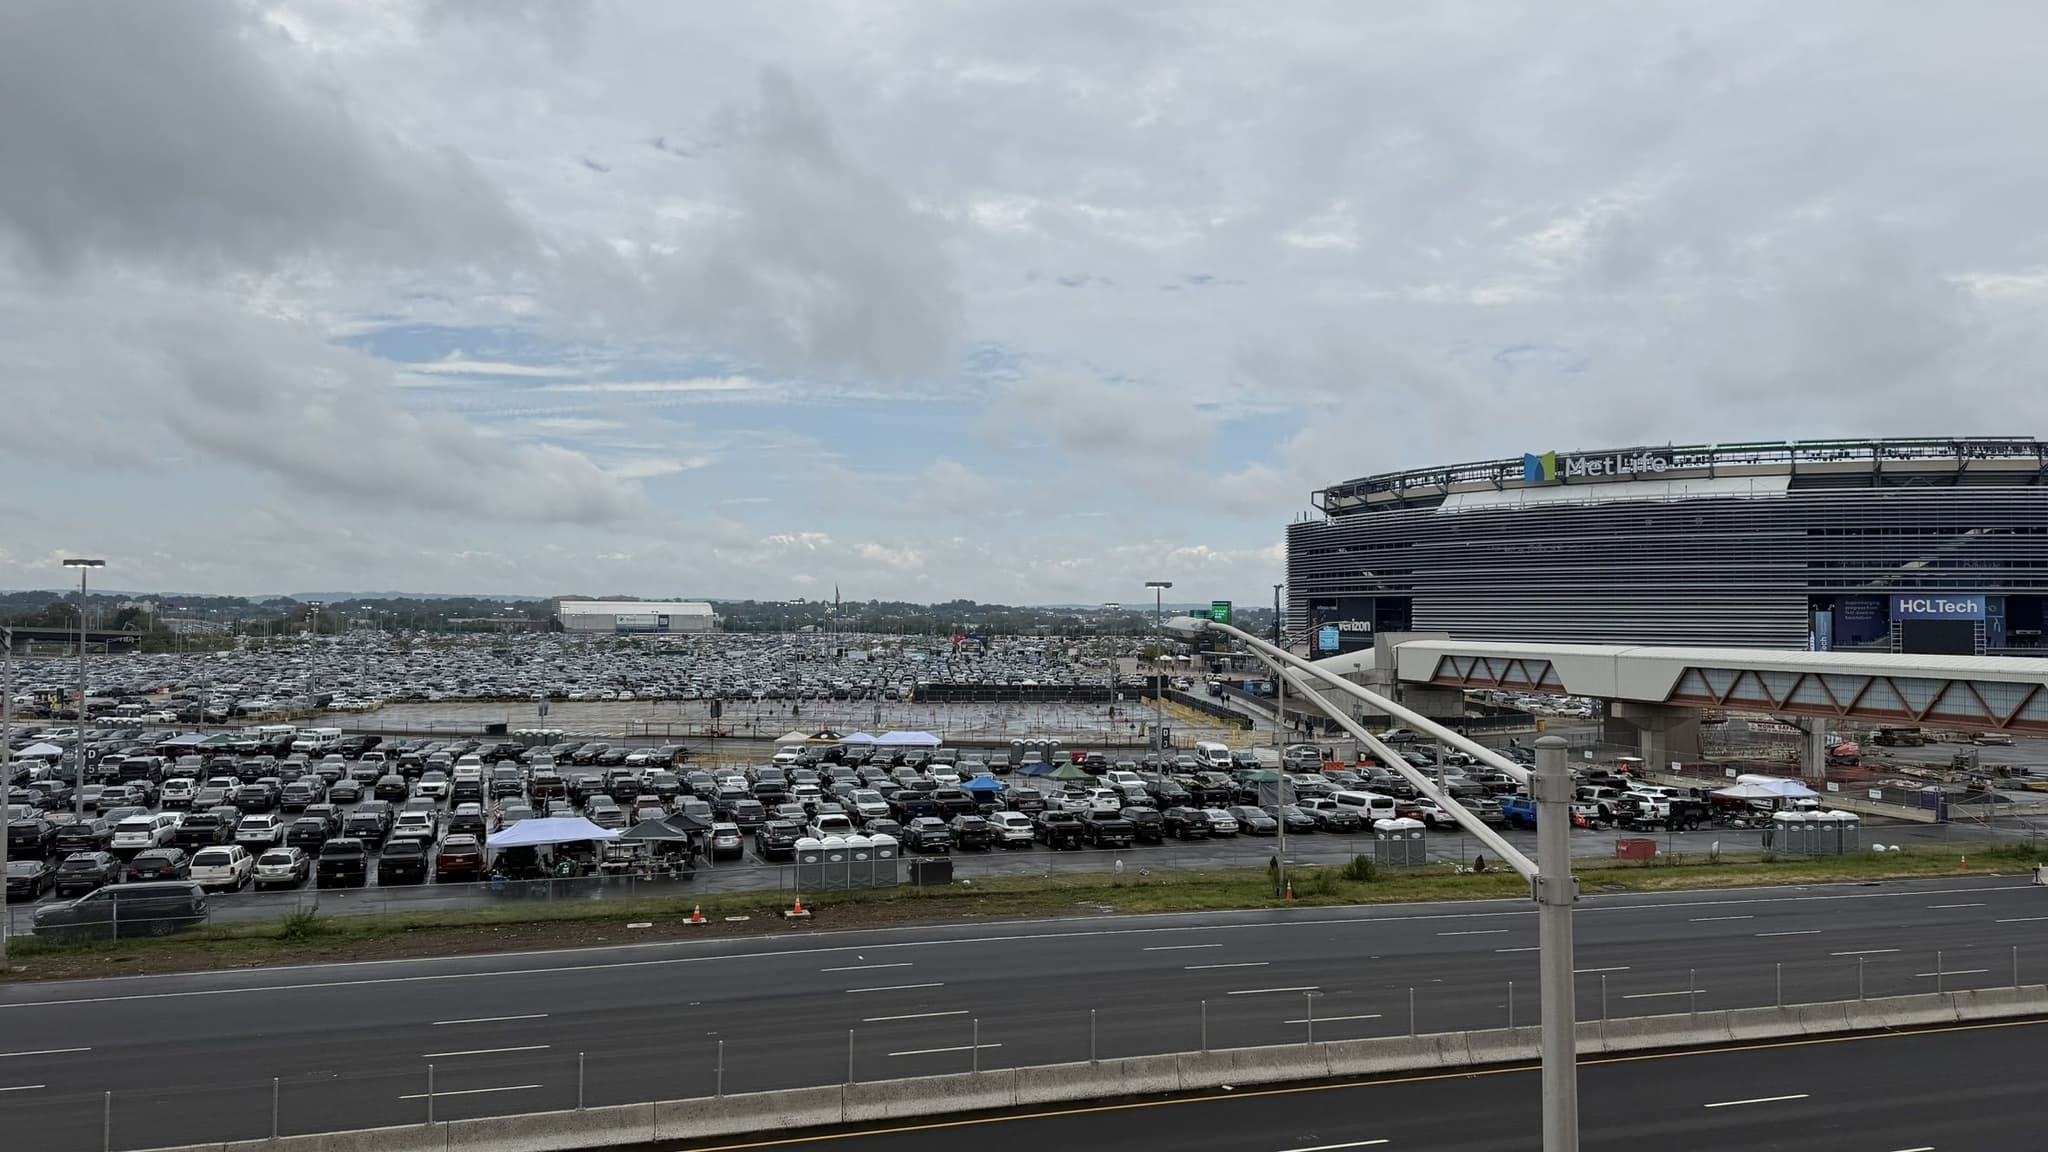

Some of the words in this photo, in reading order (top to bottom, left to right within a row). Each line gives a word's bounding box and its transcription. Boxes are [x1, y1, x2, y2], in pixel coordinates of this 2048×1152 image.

[1565, 452, 1667, 477] MetLife
[1899, 599, 1978, 613] HCLTech
[1338, 618, 1371, 632] verizon
[88, 750, 96, 759] D
[88, 764, 95, 773] 5
